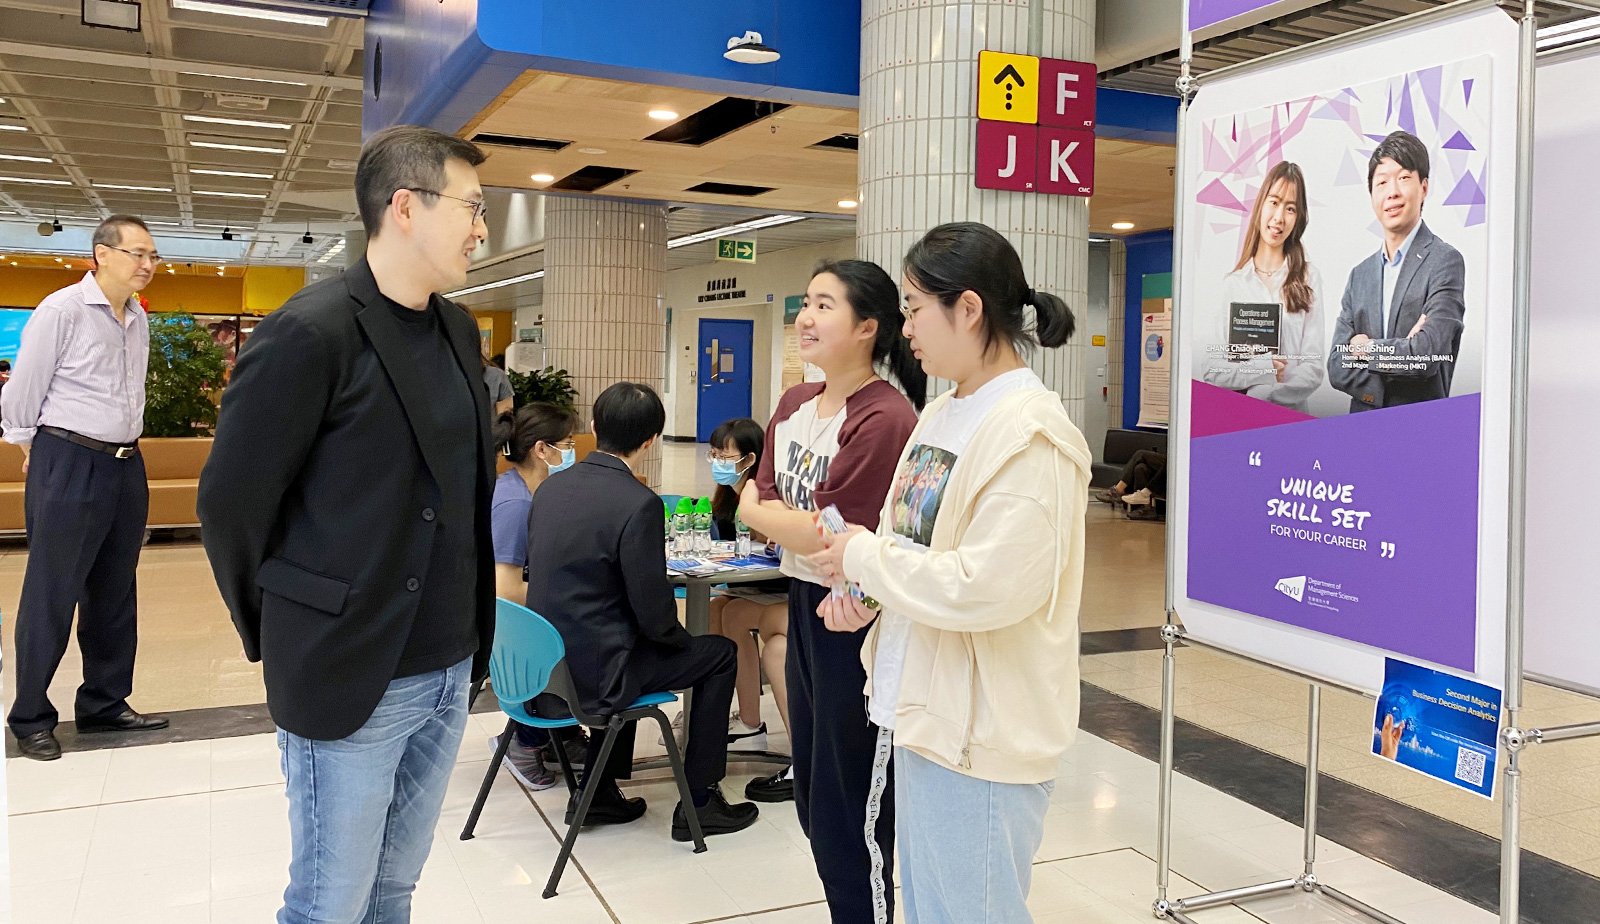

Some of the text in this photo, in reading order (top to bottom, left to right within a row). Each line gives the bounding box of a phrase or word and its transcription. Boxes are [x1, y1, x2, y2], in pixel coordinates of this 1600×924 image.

[1056, 72, 1079, 115] F
[998, 135, 1016, 178] J
[1050, 140, 1080, 184] K
[1356, 344, 1368, 352] Siu
[1371, 344, 1395, 354] Shing
[1313, 460, 1321, 470] A
[1280, 477, 1354, 503] UNIQUE
[1267, 498, 1371, 530] SKILL SET
[1270, 524, 1366, 551] FOR YOUR CAREER
[1308, 577, 1335, 589] Department
[1308, 585, 1338, 596] Management
[1339, 592, 1358, 602] Sciences
[1412, 689, 1496, 722] Business Decision Analytics
[1446, 688, 1497, 710] Second Major in
